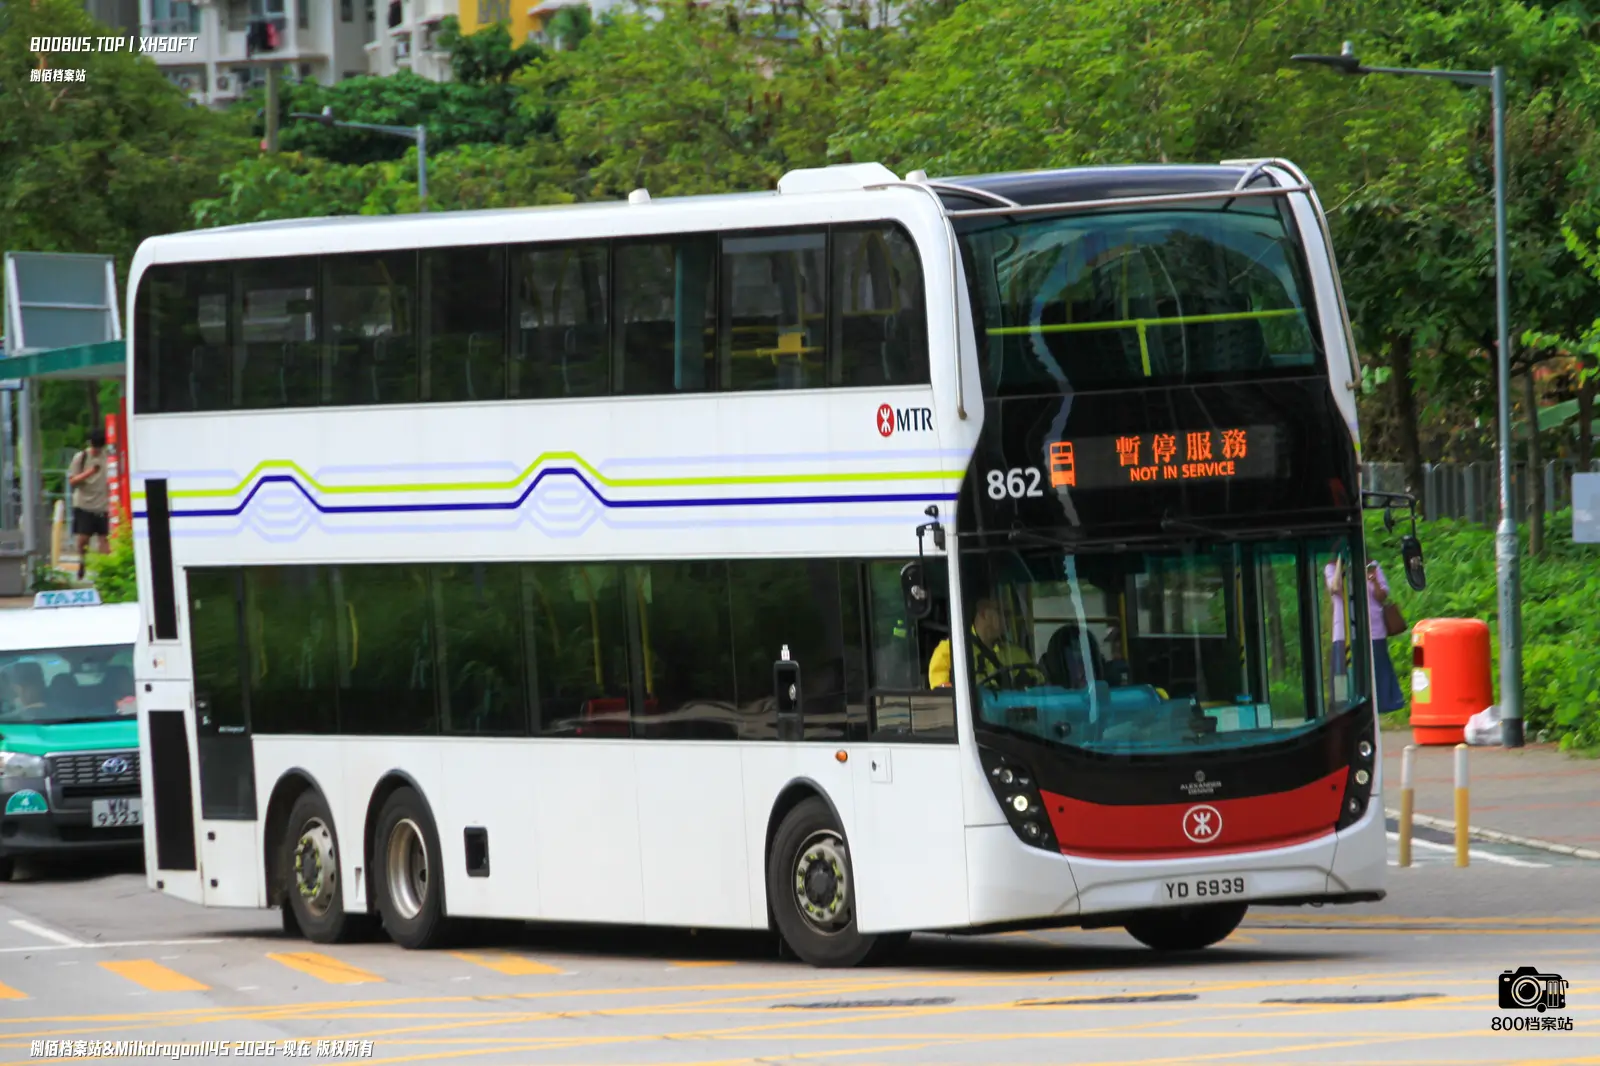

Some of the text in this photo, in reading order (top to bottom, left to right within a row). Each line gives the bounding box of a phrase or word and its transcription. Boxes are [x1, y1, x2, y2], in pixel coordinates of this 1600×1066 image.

[896, 407, 933, 431] MTR
[1115, 429, 1247, 467] 暫停服務
[1130, 460, 1235, 482] NOT IN SERVICE
[986, 466, 1043, 500] 862
[42, 589, 94, 605] TAXI
[1180, 780, 1222, 791] ALEXANDER
[97, 810, 140, 827] 9323
[1165, 877, 1244, 899] YD 6939
